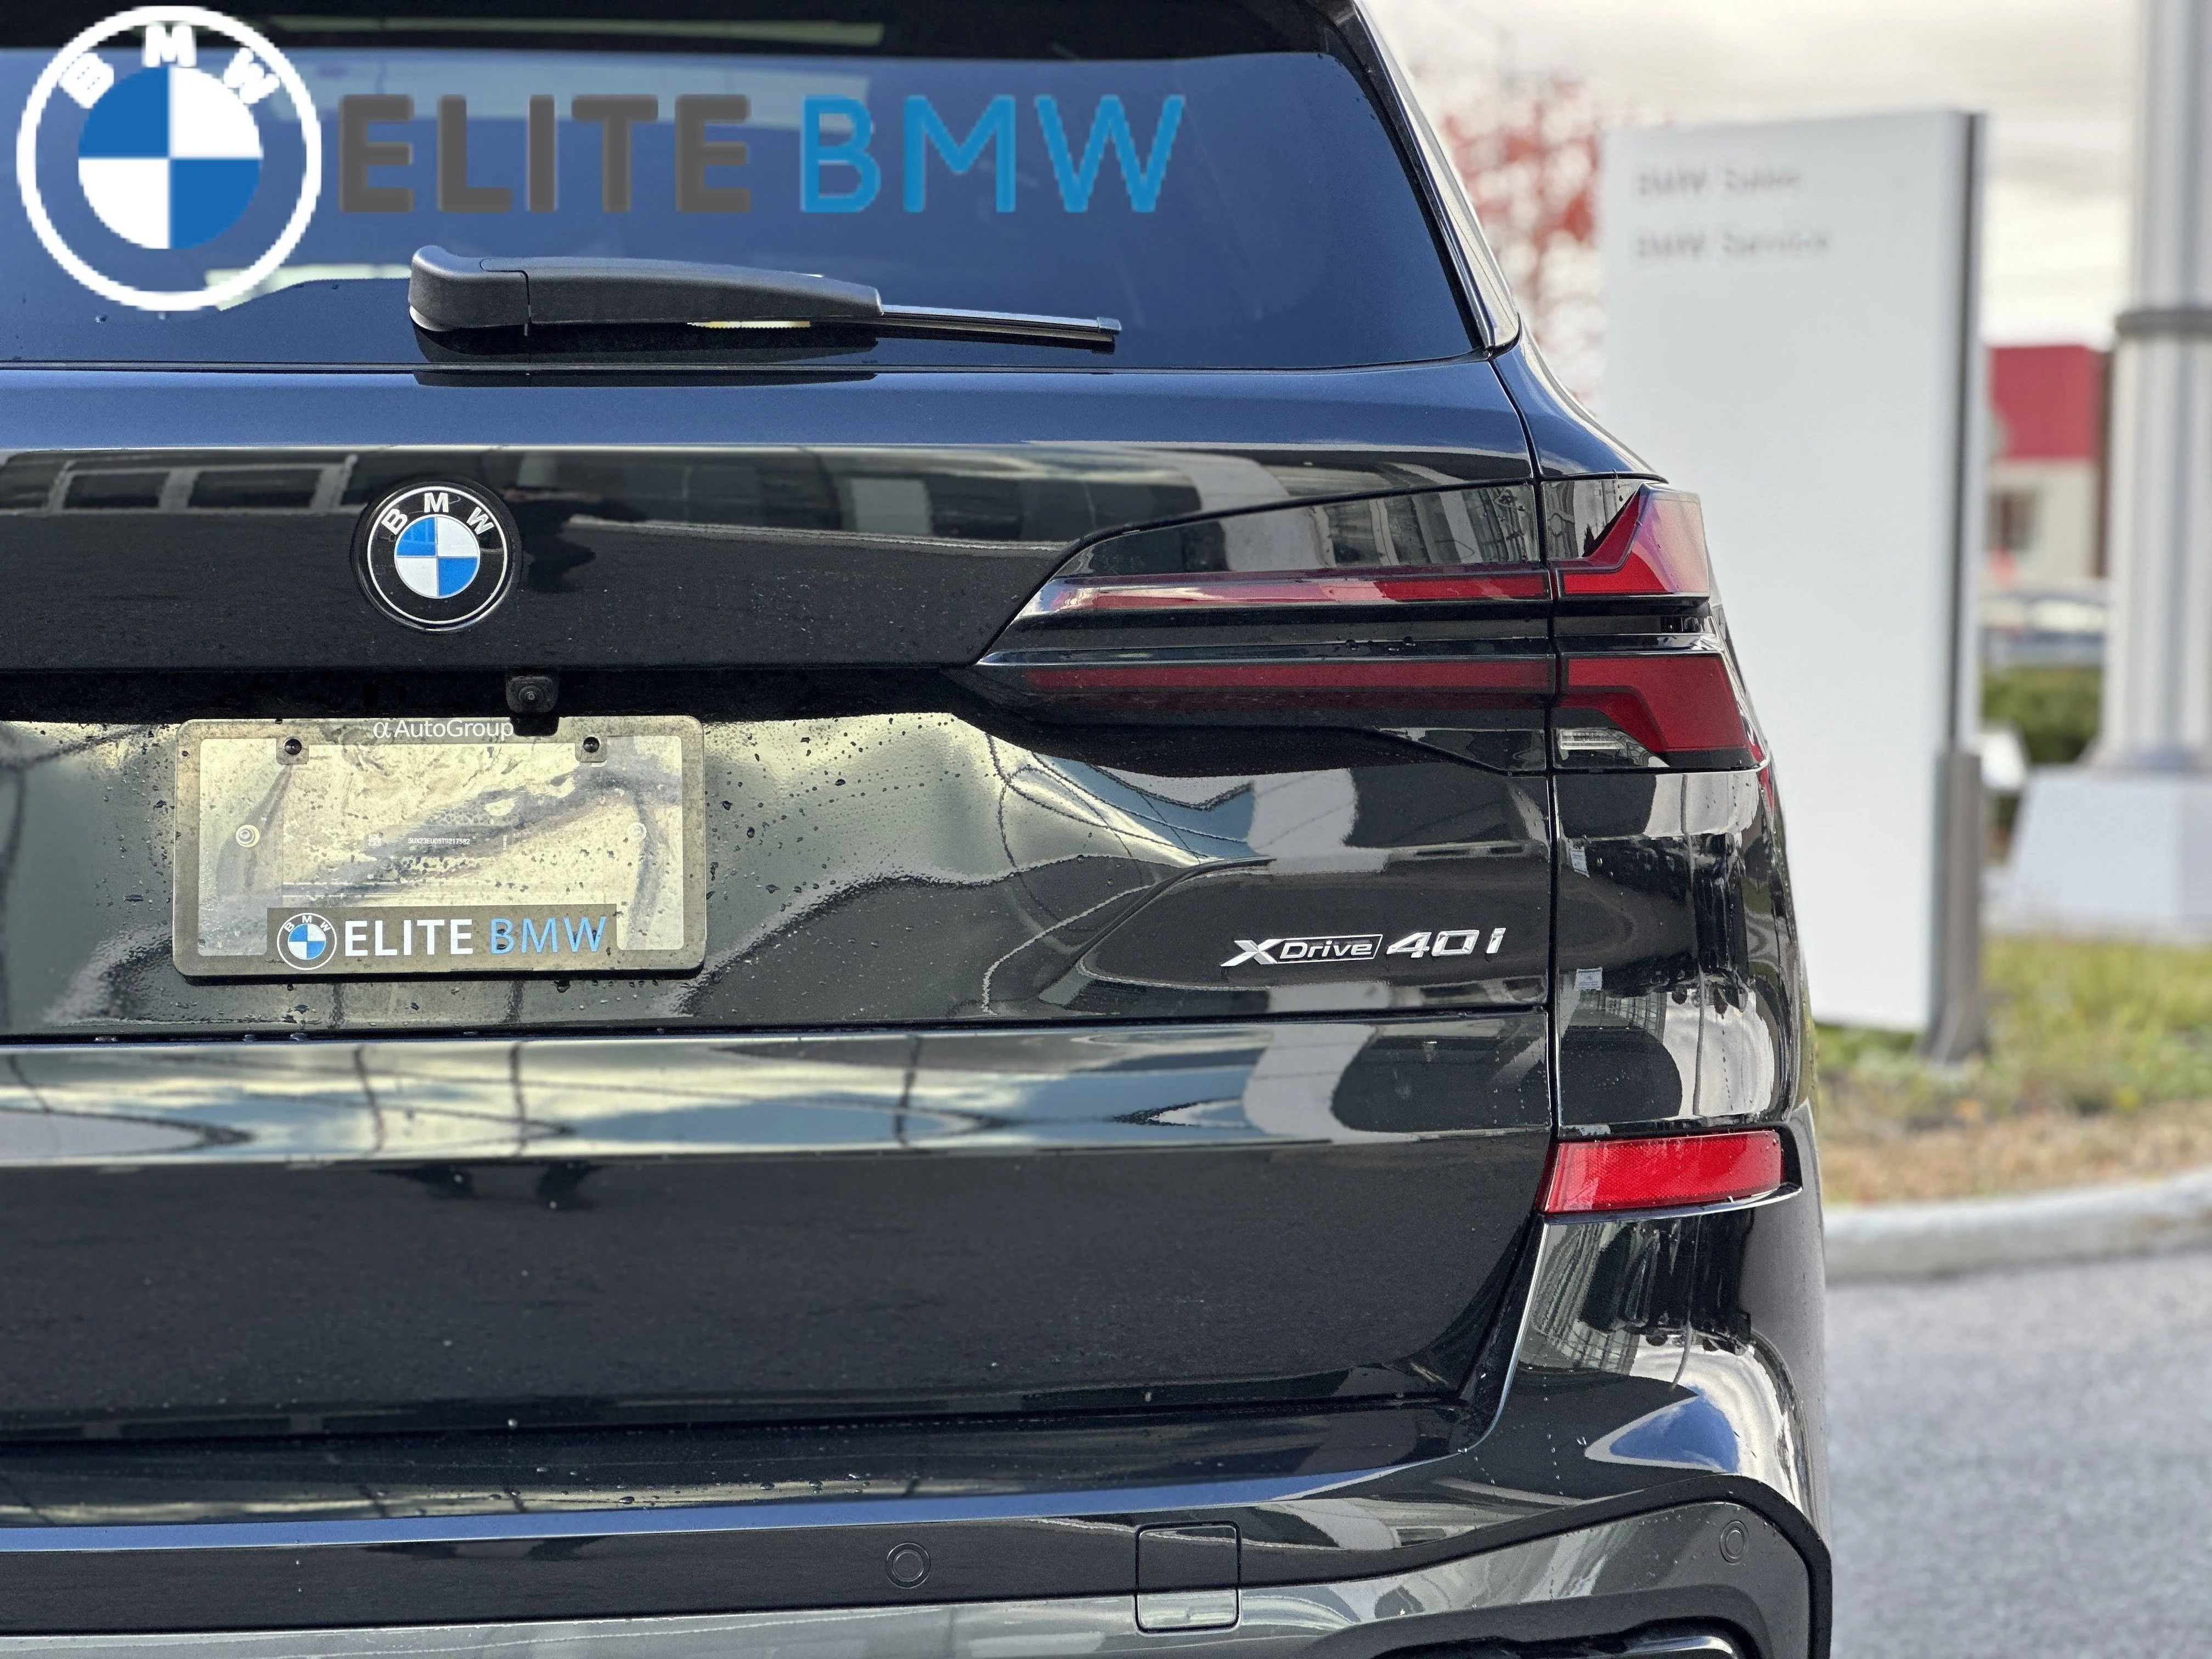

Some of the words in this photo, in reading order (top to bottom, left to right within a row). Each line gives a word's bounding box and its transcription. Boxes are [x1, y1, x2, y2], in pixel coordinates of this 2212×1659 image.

[381, 492, 494, 535] BMW
[394, 719, 514, 741] AutoGroup
[284, 915, 331, 932] BMW
[344, 919, 473, 956] ELITE
[490, 917, 607, 955] BMW
